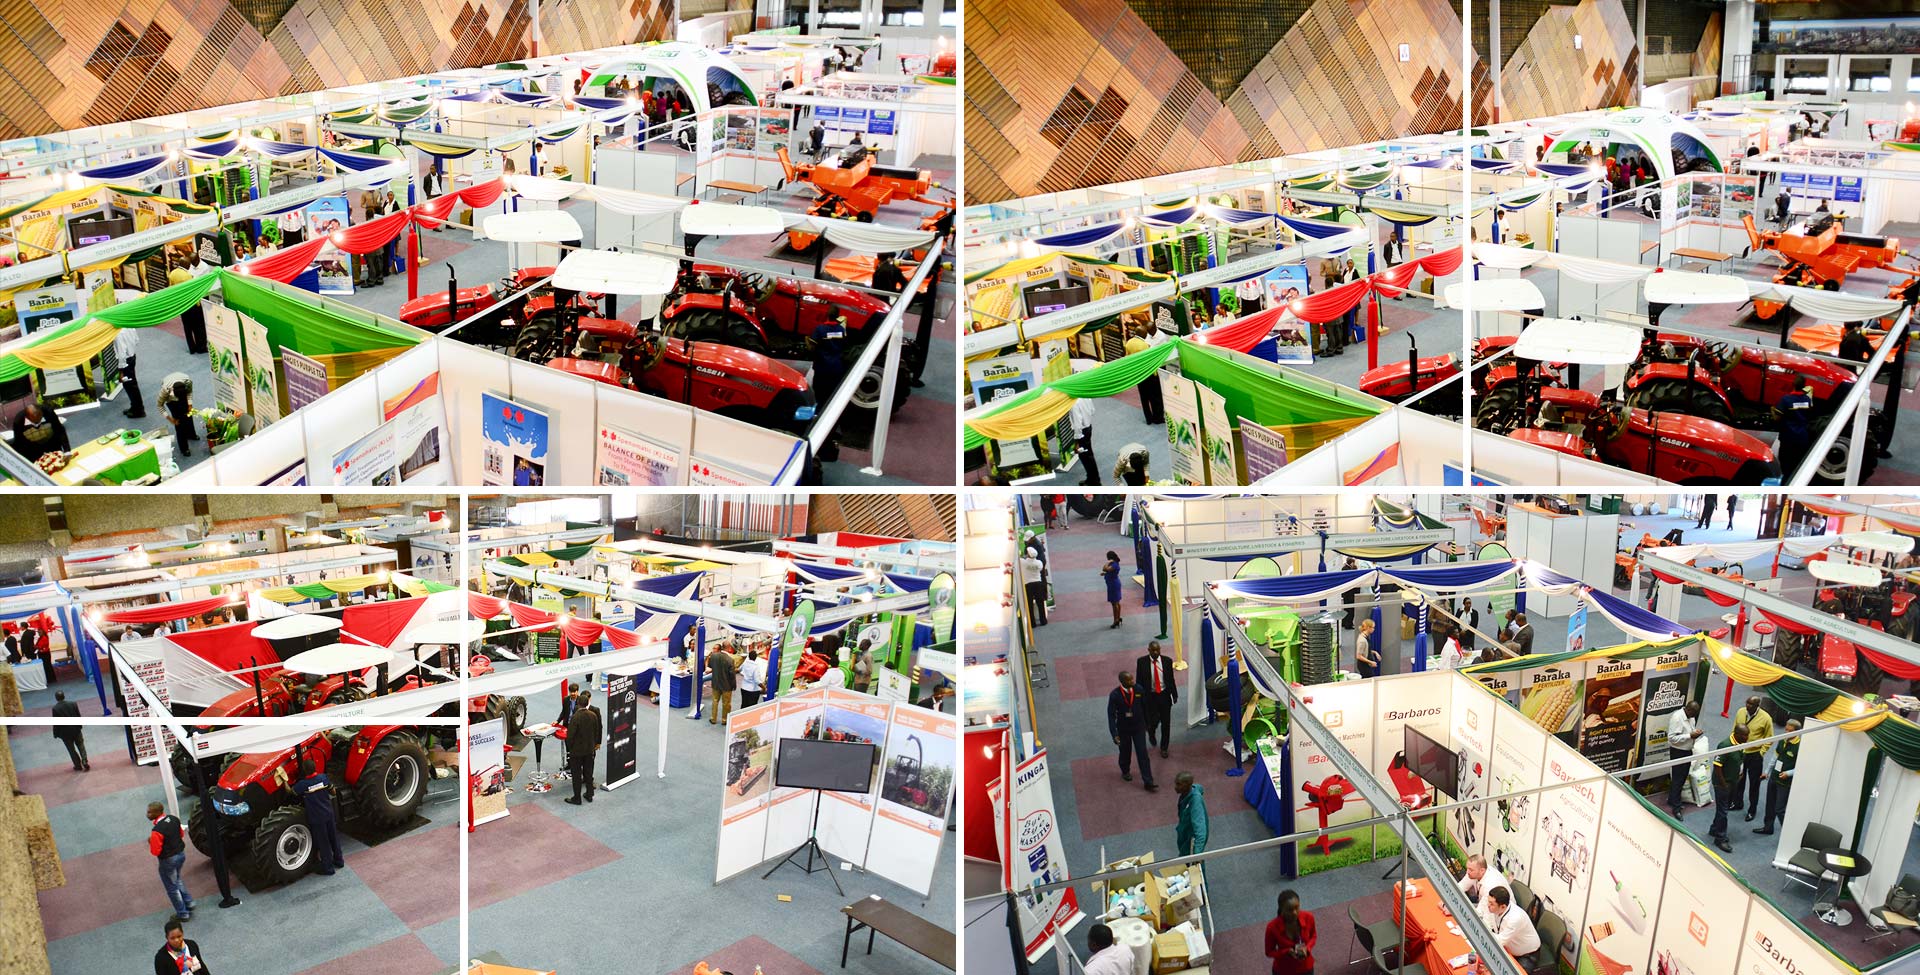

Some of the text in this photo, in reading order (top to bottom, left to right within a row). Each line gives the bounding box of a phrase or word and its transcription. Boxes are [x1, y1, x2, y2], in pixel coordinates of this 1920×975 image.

[72, 198, 98, 209] Baraka
[22, 210, 51, 221] Baraka
[1026, 266, 1053, 277] Baraka
[1094, 269, 1111, 280] Baraka
[976, 278, 1006, 290] Baraka
[29, 296, 64, 307] Baraka
[41, 318, 59, 327] Pata
[316, 369, 325, 378] TEA
[696, 365, 717, 375] CASE
[983, 364, 1019, 376] Baraka
[995, 388, 1014, 399] Pata
[618, 436, 651, 453] Spenomatic
[1275, 440, 1284, 449] TEA
[1660, 436, 1681, 447] CASE
[603, 442, 670, 472] BALANCE OF PLANT
[608, 451, 622, 461] From
[624, 456, 640, 468] Steam
[1809, 615, 1856, 635] CASE AGRICULTURE
[1657, 653, 1689, 665] Baraka
[560, 662, 592, 672] AGRICULTURE
[1597, 661, 1632, 674] Baraka
[1533, 670, 1571, 684] Baraka
[1601, 671, 1626, 680] FERTILIZER
[1538, 680, 1565, 689] FERTILIZER
[1660, 682, 1677, 691] Pata
[1655, 690, 1680, 701] Baraka
[1648, 695, 1685, 711] Shambani
[1388, 707, 1442, 720] Barbaros
[1603, 725, 1627, 734] FERTILIZER
[475, 736, 495, 746] SUCCESS
[1342, 732, 1366, 741] Machines
[1649, 731, 1668, 740] Barak
[1299, 740, 1312, 748] Feed
[1588, 738, 1616, 748] right quantity
[1017, 762, 1045, 787] KINGA
[1024, 813, 1042, 829] Bye
[1022, 819, 1046, 836] Bye
[1019, 823, 1051, 847] MASTITIS
[1439, 879, 1460, 907] MOTOR
[1456, 904, 1482, 938] MAKINA
[1479, 936, 1502, 969] SANAYI
